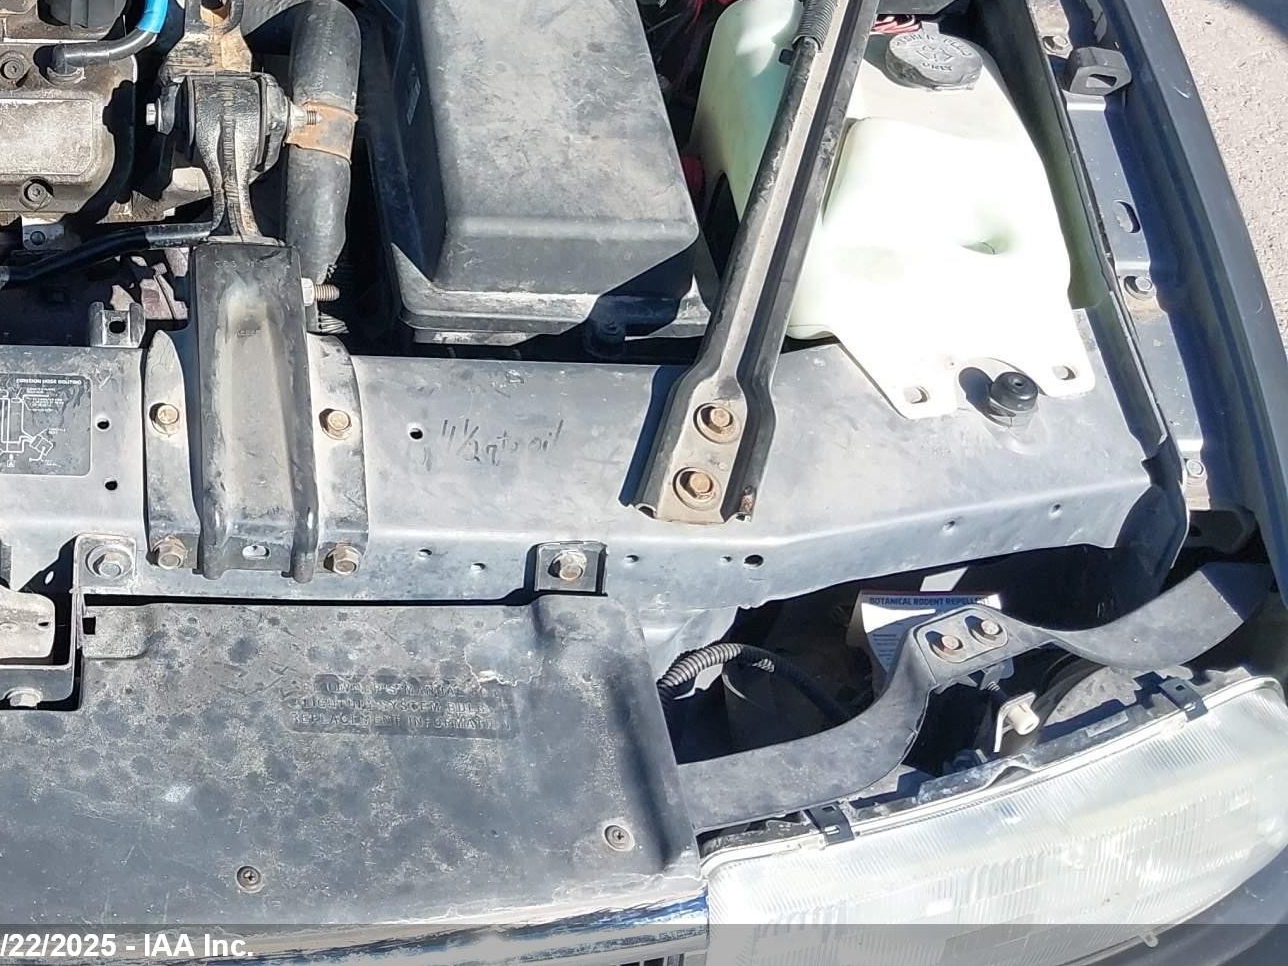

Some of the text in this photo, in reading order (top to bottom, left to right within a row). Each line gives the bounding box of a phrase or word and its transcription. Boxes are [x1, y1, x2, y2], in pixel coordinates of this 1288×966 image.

[869, 597, 912, 605] BOTANICAL
[913, 598, 944, 606] RODENT
[293, 713, 512, 731] REPLACEMENT INFORMATION
